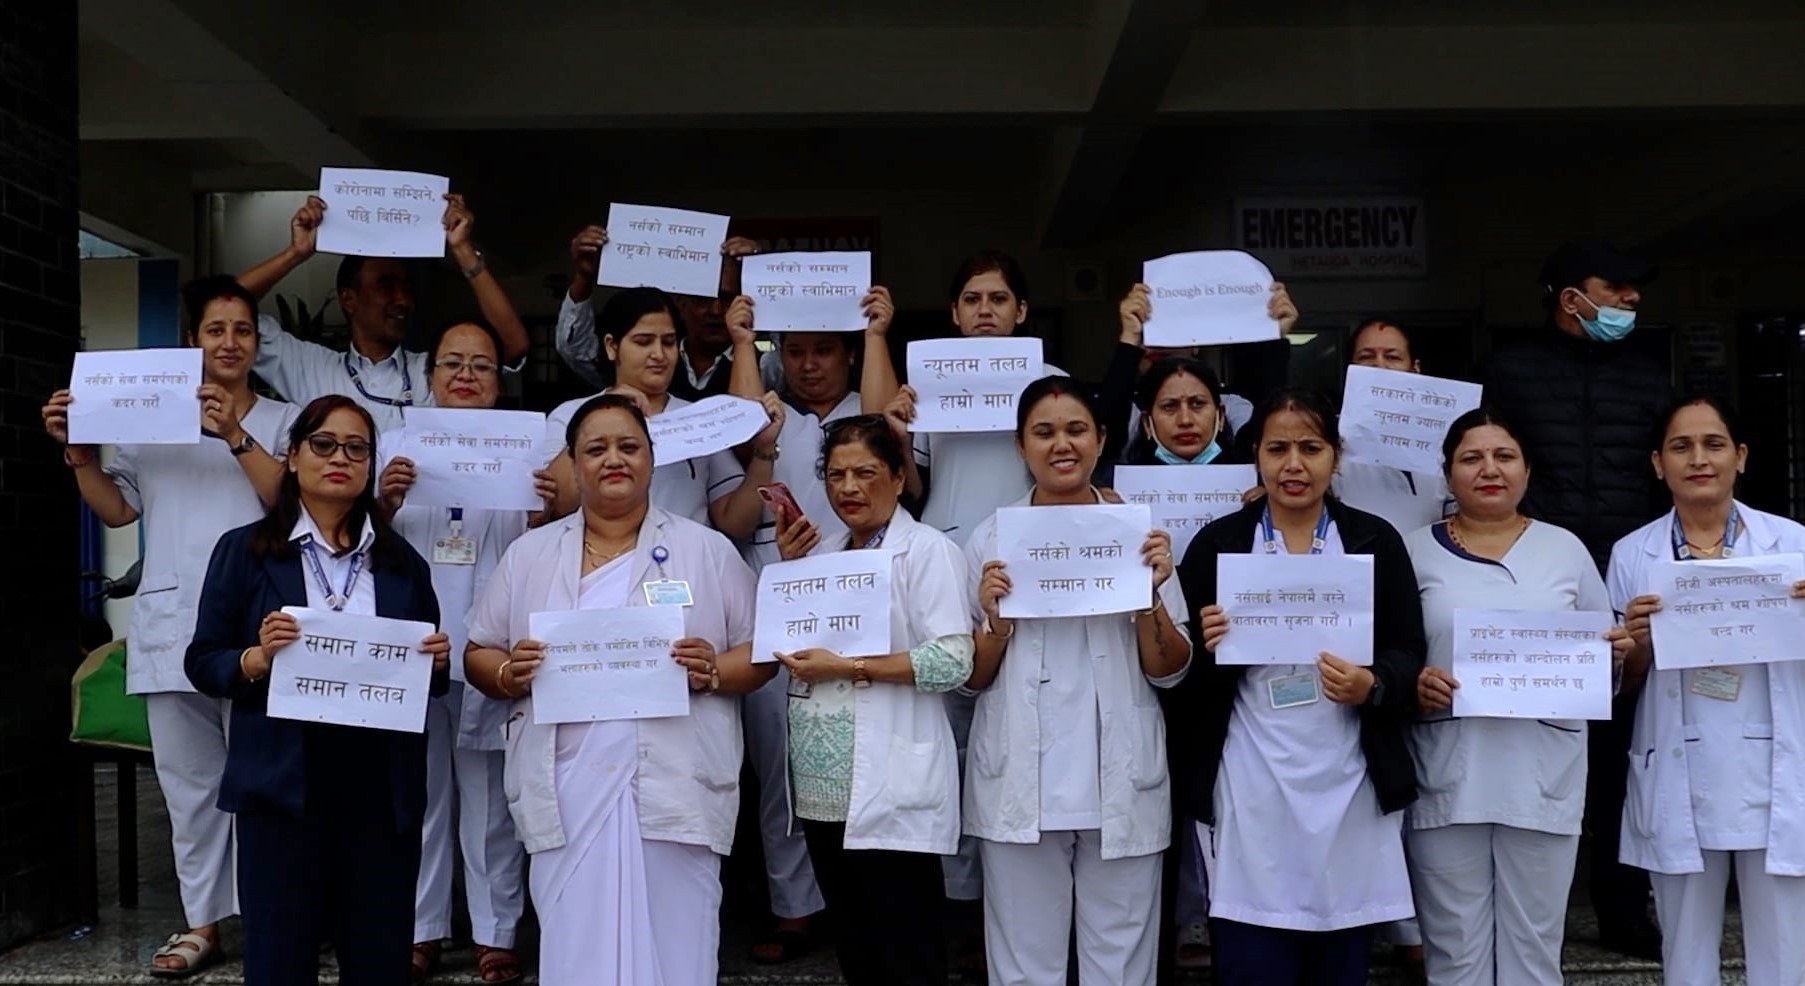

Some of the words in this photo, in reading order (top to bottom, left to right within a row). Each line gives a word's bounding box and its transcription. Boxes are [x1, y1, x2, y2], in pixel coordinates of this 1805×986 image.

[334, 181, 386, 197] कोरोनामा
[346, 206, 371, 224] पछि
[629, 218, 662, 233] नर्सको
[667, 223, 706, 237] सम्मान
[1243, 206, 1418, 249] EMERGENCY
[616, 241, 652, 259] राष्ट्रको
[657, 245, 710, 263] स्वाभिमान
[766, 261, 801, 273] नर्सको
[808, 264, 848, 273] सम्मान
[757, 281, 794, 302] राष्ट्रको
[802, 281, 857, 297] स्वाभिमान
[1156, 285, 1201, 299] Enough
[1204, 286, 1214, 296] is
[1217, 282, 1263, 296] Enough
[922, 358, 981, 379] न्यूनतम
[84, 373, 113, 386] नर्सको
[118, 373, 137, 384] सेवा
[142, 371, 189, 385] समर्पणको
[111, 397, 137, 409] कदर
[938, 388, 974, 410] हाम्रो
[982, 393, 1013, 407] माग
[1370, 386, 1416, 402] सरकारले
[1420, 390, 1457, 408] तोकेको
[1374, 409, 1410, 425] न्यूनतम
[1415, 416, 1446, 430] ज्याला
[419, 432, 450, 447] नर्सको
[456, 433, 477, 448] सेवा
[482, 434, 532, 449] समर्पणको
[1380, 434, 1410, 448] कायम
[1416, 440, 1431, 452] गर
[451, 461, 478, 472] कदर
[1129, 489, 1160, 504] नर्सको
[1166, 489, 1187, 504] सेवा
[1162, 518, 1189, 529] कदर
[1028, 541, 1070, 561] नर्सको
[1078, 539, 1123, 560] श्रमको
[772, 577, 828, 603] न्यूनतम
[1038, 578, 1086, 593] सम्मान
[1094, 577, 1115, 591] गर
[1675, 576, 1701, 591] निजी
[1234, 589, 1271, 604] नर्सलाई
[1278, 588, 1316, 603] नेपालमै
[1731, 599, 1750, 611] श्रम
[1756, 595, 1788, 608] शोषण
[786, 612, 819, 638] हाम्रो
[826, 614, 861, 632] माग
[1230, 615, 1278, 627] वातावरण
[1284, 615, 1314, 630] सृजना
[1738, 624, 1756, 636] गर
[1469, 625, 1505, 640] प्राइभेट
[1510, 629, 1548, 640] स्वास्थ्य
[1554, 628, 1596, 640] संस्थाका
[304, 634, 358, 657] समान
[368, 642, 410, 662] काम
[545, 641, 577, 655] नियमले
[581, 640, 600, 652] तोके
[645, 659, 658, 669] गर
[1523, 650, 1570, 664] आन्दोलन
[1576, 651, 1597, 665] प्रति
[295, 676, 349, 698] समान
[1480, 673, 1504, 688] हाम्रो
[1532, 675, 1568, 689] समर्थन
[1572, 677, 1585, 691] छ
